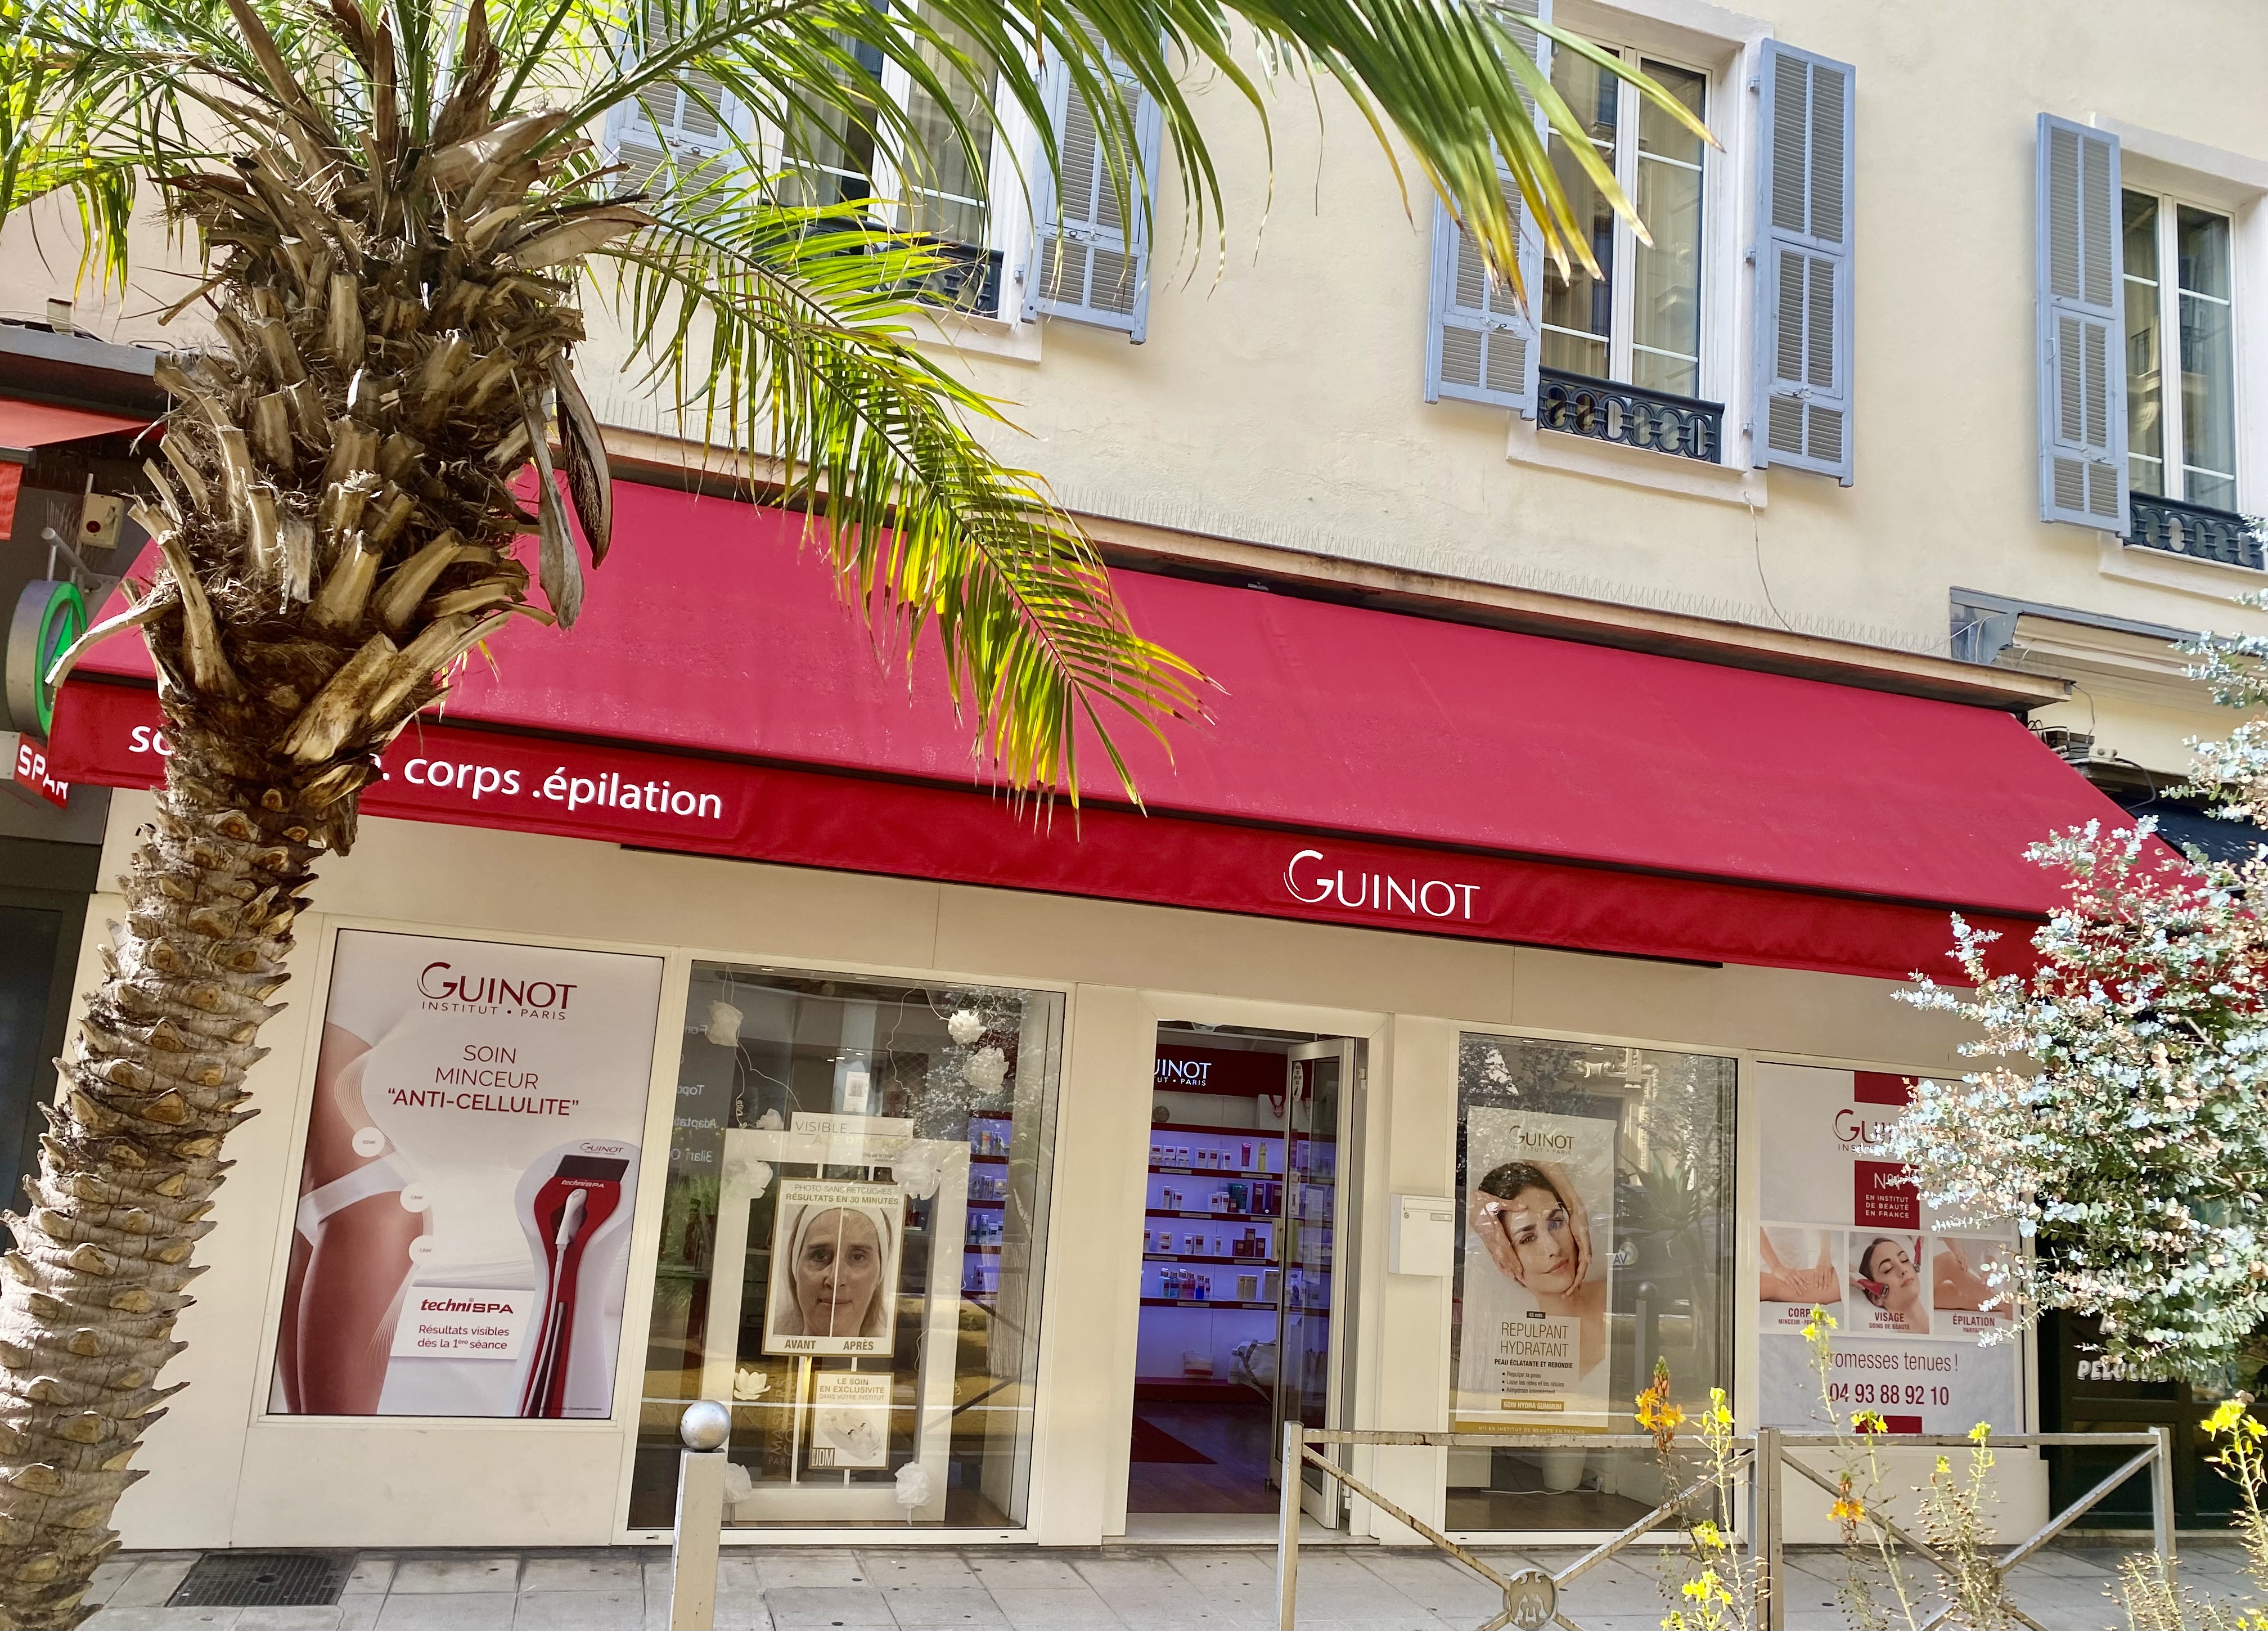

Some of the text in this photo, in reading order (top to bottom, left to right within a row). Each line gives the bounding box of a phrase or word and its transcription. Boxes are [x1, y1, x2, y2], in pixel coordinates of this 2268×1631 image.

[404, 757, 520, 799] corps
[1283, 850, 1480, 919] GUINOT
[417, 961, 577, 1009] GUINOT
[421, 1001, 566, 1021] INSTITUT PARIS
[463, 1045, 517, 1064] SOIN
[1154, 1058, 1212, 1079] UINOT
[435, 1067, 539, 1090] MINCEUR
[795, 1121, 848, 1134] VISIBLE
[1508, 1125, 1575, 1149] GUINOT
[579, 1143, 625, 1153] GUINOT
[785, 1192, 834, 1202] RÉSULTATS
[420, 1297, 514, 1314] techniSPA
[1788, 1308, 1811, 1318] CORP
[1874, 1312, 1904, 1322] VISAGE
[1953, 1314, 1995, 1327] ÉPILATION
[418, 1324, 510, 1336] Résultats visibles
[1501, 1322, 1569, 1339] REPULPANT
[417, 1338, 437, 1347] dès
[440, 1338, 449, 1348] la
[469, 1340, 507, 1349] séance
[784, 1338, 874, 1350] AVANT APRÈS
[1500, 1340, 1569, 1357] HYDRATANT
[1510, 1359, 1539, 1367] ÉCLATANTE
[1828, 1352, 1898, 1369] romesses
[1830, 1382, 1949, 1405] 04 93 88 92 10
